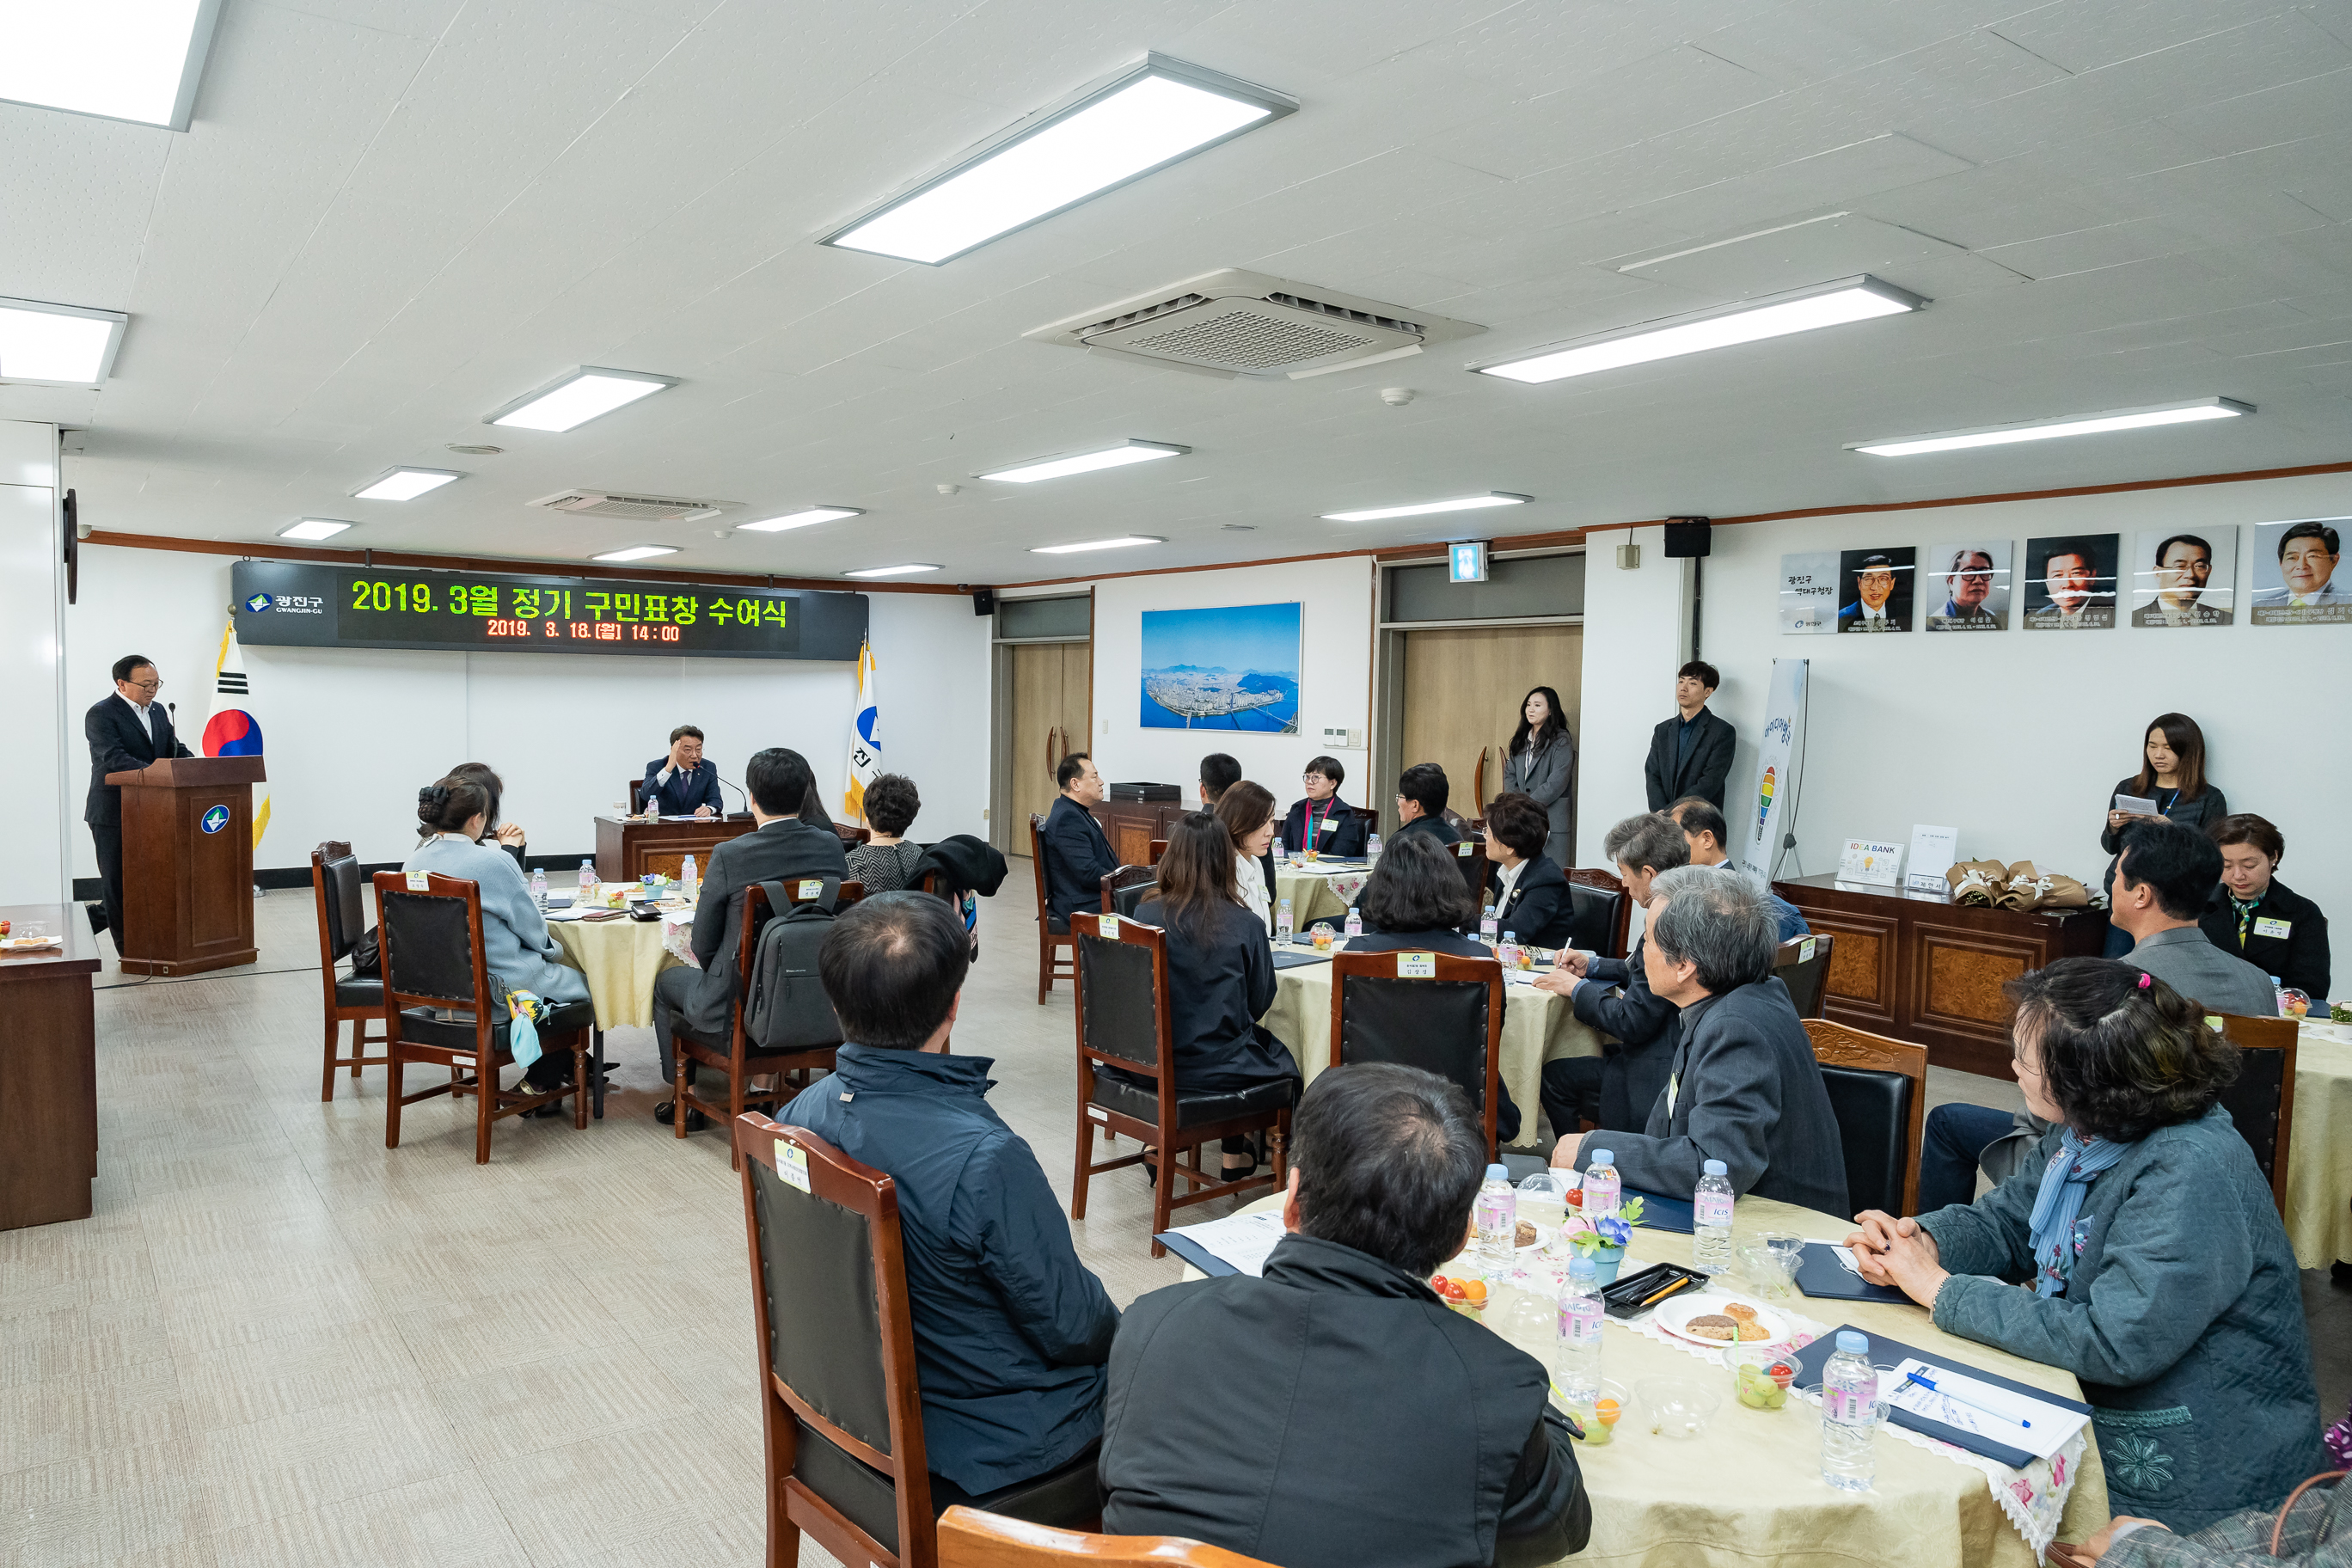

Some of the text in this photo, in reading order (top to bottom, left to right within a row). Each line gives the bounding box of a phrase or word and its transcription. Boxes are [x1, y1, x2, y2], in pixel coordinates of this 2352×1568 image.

[1788, 575, 1812, 585] 광진구
[1795, 586, 1834, 596] 역대구청장
[275, 595, 323, 608] 광진구
[352, 581, 787, 628] 2019. 3월 정기 구민표창 수여식
[487, 619, 531, 636] 2019.
[545, 622, 560, 637] 3.
[1871, 845, 1896, 854] BANK
